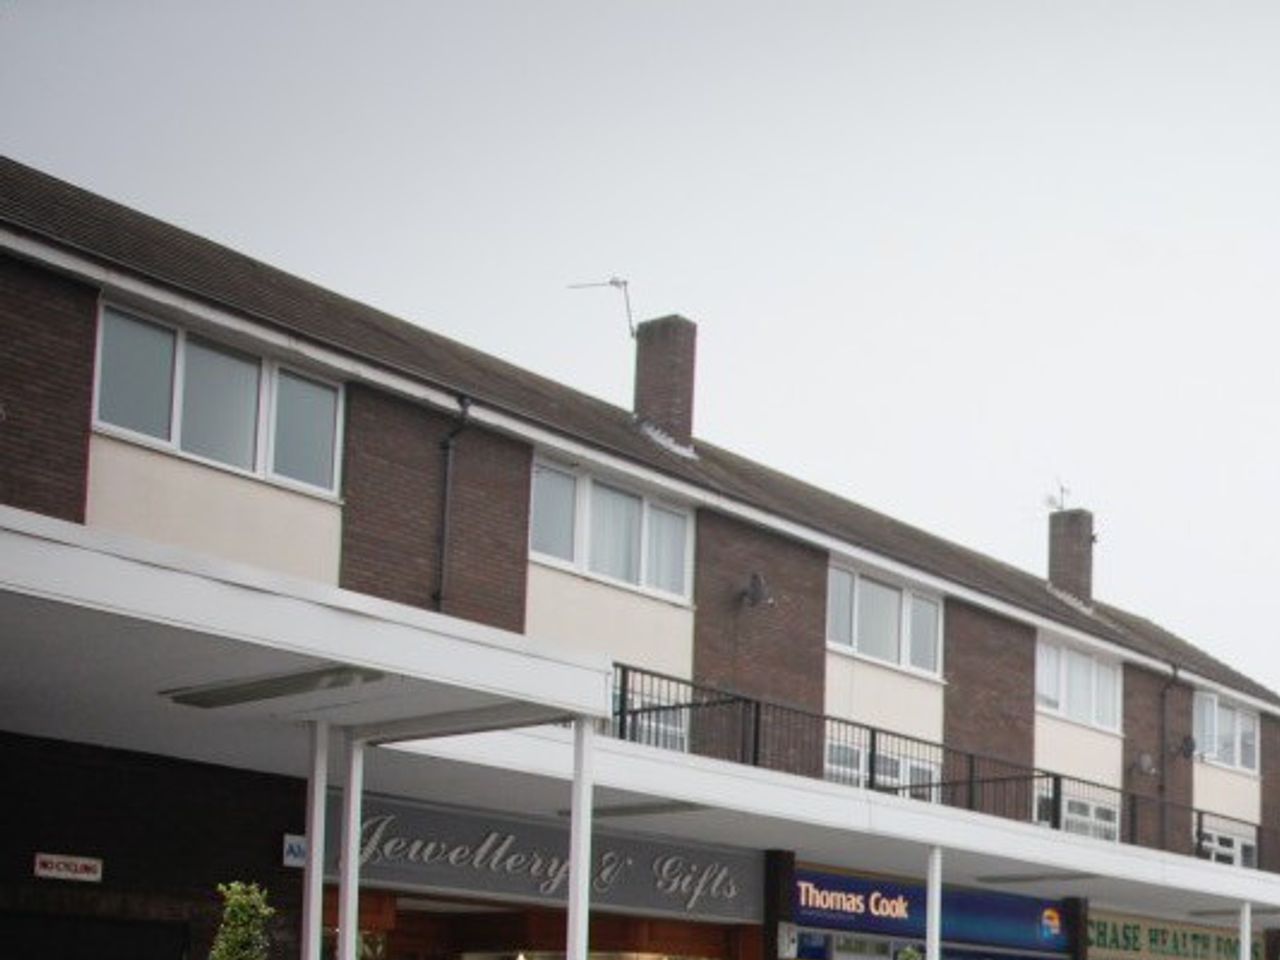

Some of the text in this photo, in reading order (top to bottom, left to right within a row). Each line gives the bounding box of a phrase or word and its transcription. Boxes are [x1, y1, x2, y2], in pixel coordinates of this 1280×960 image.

[38, 860, 98, 875] NO CYCLING
[344, 813, 572, 894] Jewellery
[653, 854, 739, 909] Gifts
[797, 881, 909, 920] Thomas Cook
[1086, 918, 1141, 952] CHASE
[1147, 928, 1210, 960] HEALTH
